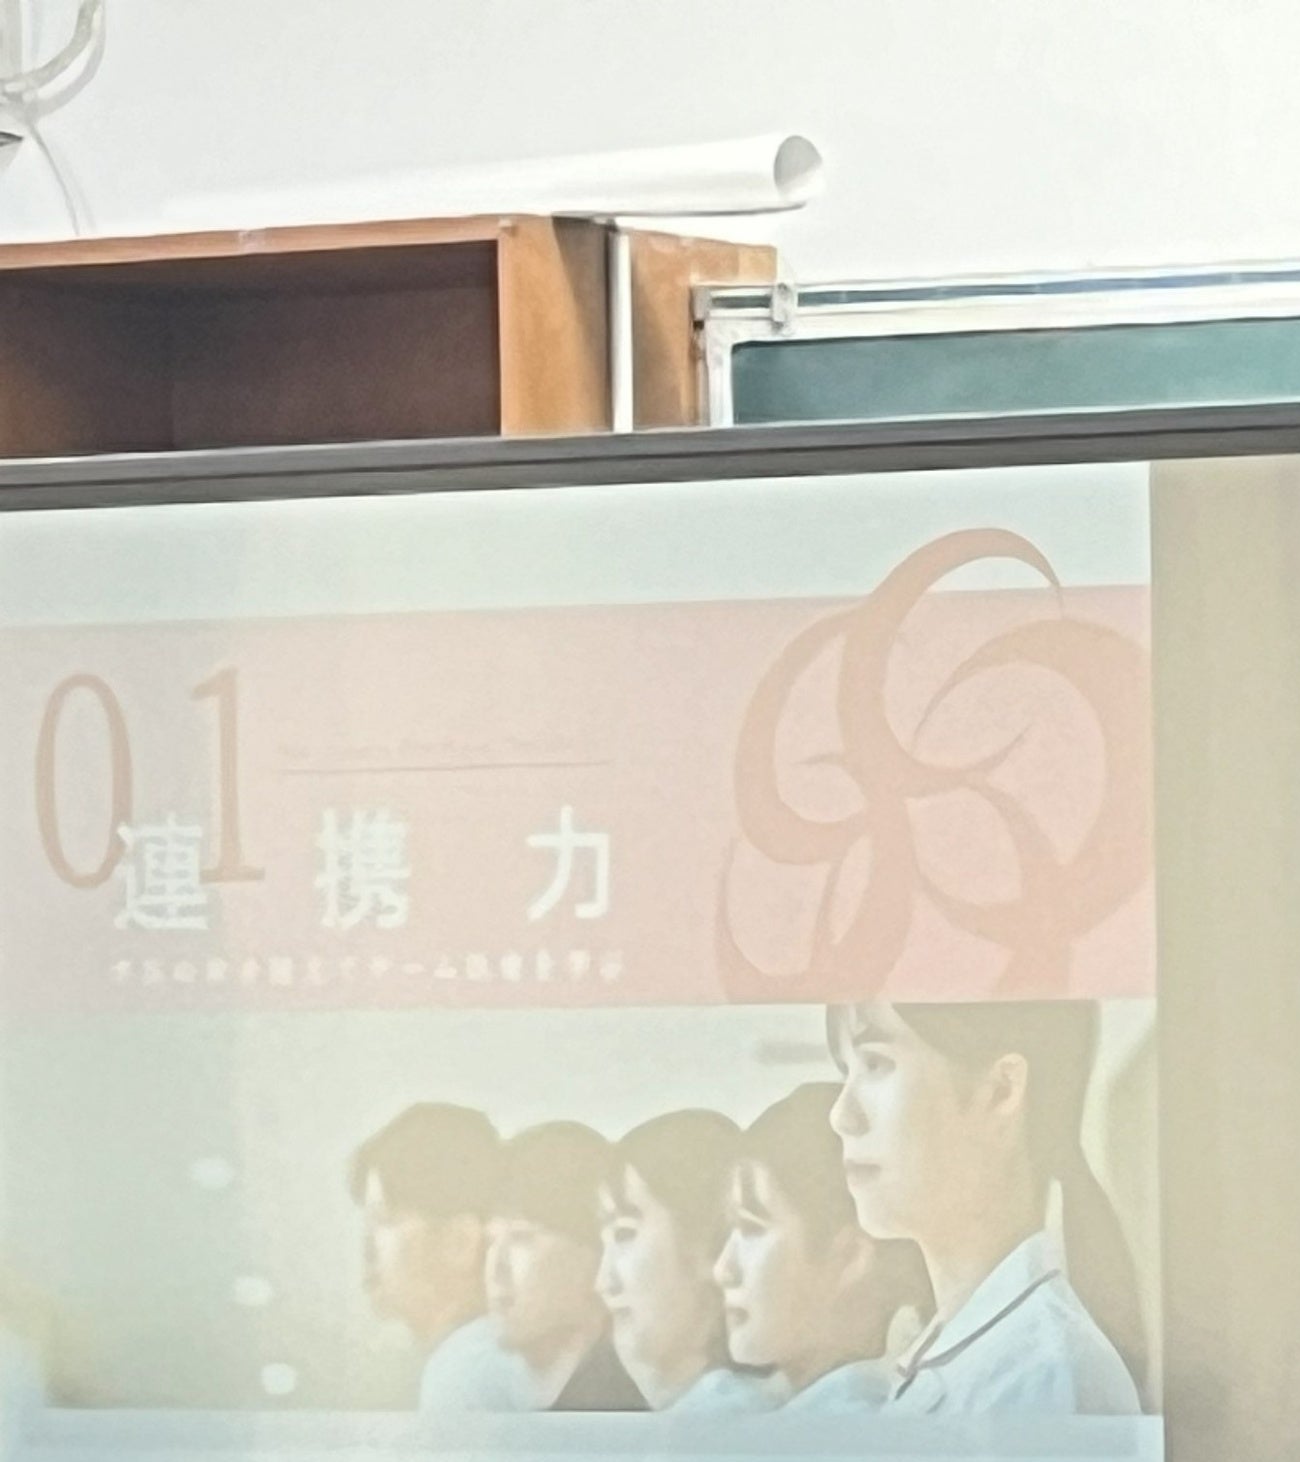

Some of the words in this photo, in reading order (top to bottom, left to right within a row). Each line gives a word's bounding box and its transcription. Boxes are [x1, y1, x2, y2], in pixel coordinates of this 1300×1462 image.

[34, 665, 266, 890] 01
[112, 804, 613, 931] 連携力
